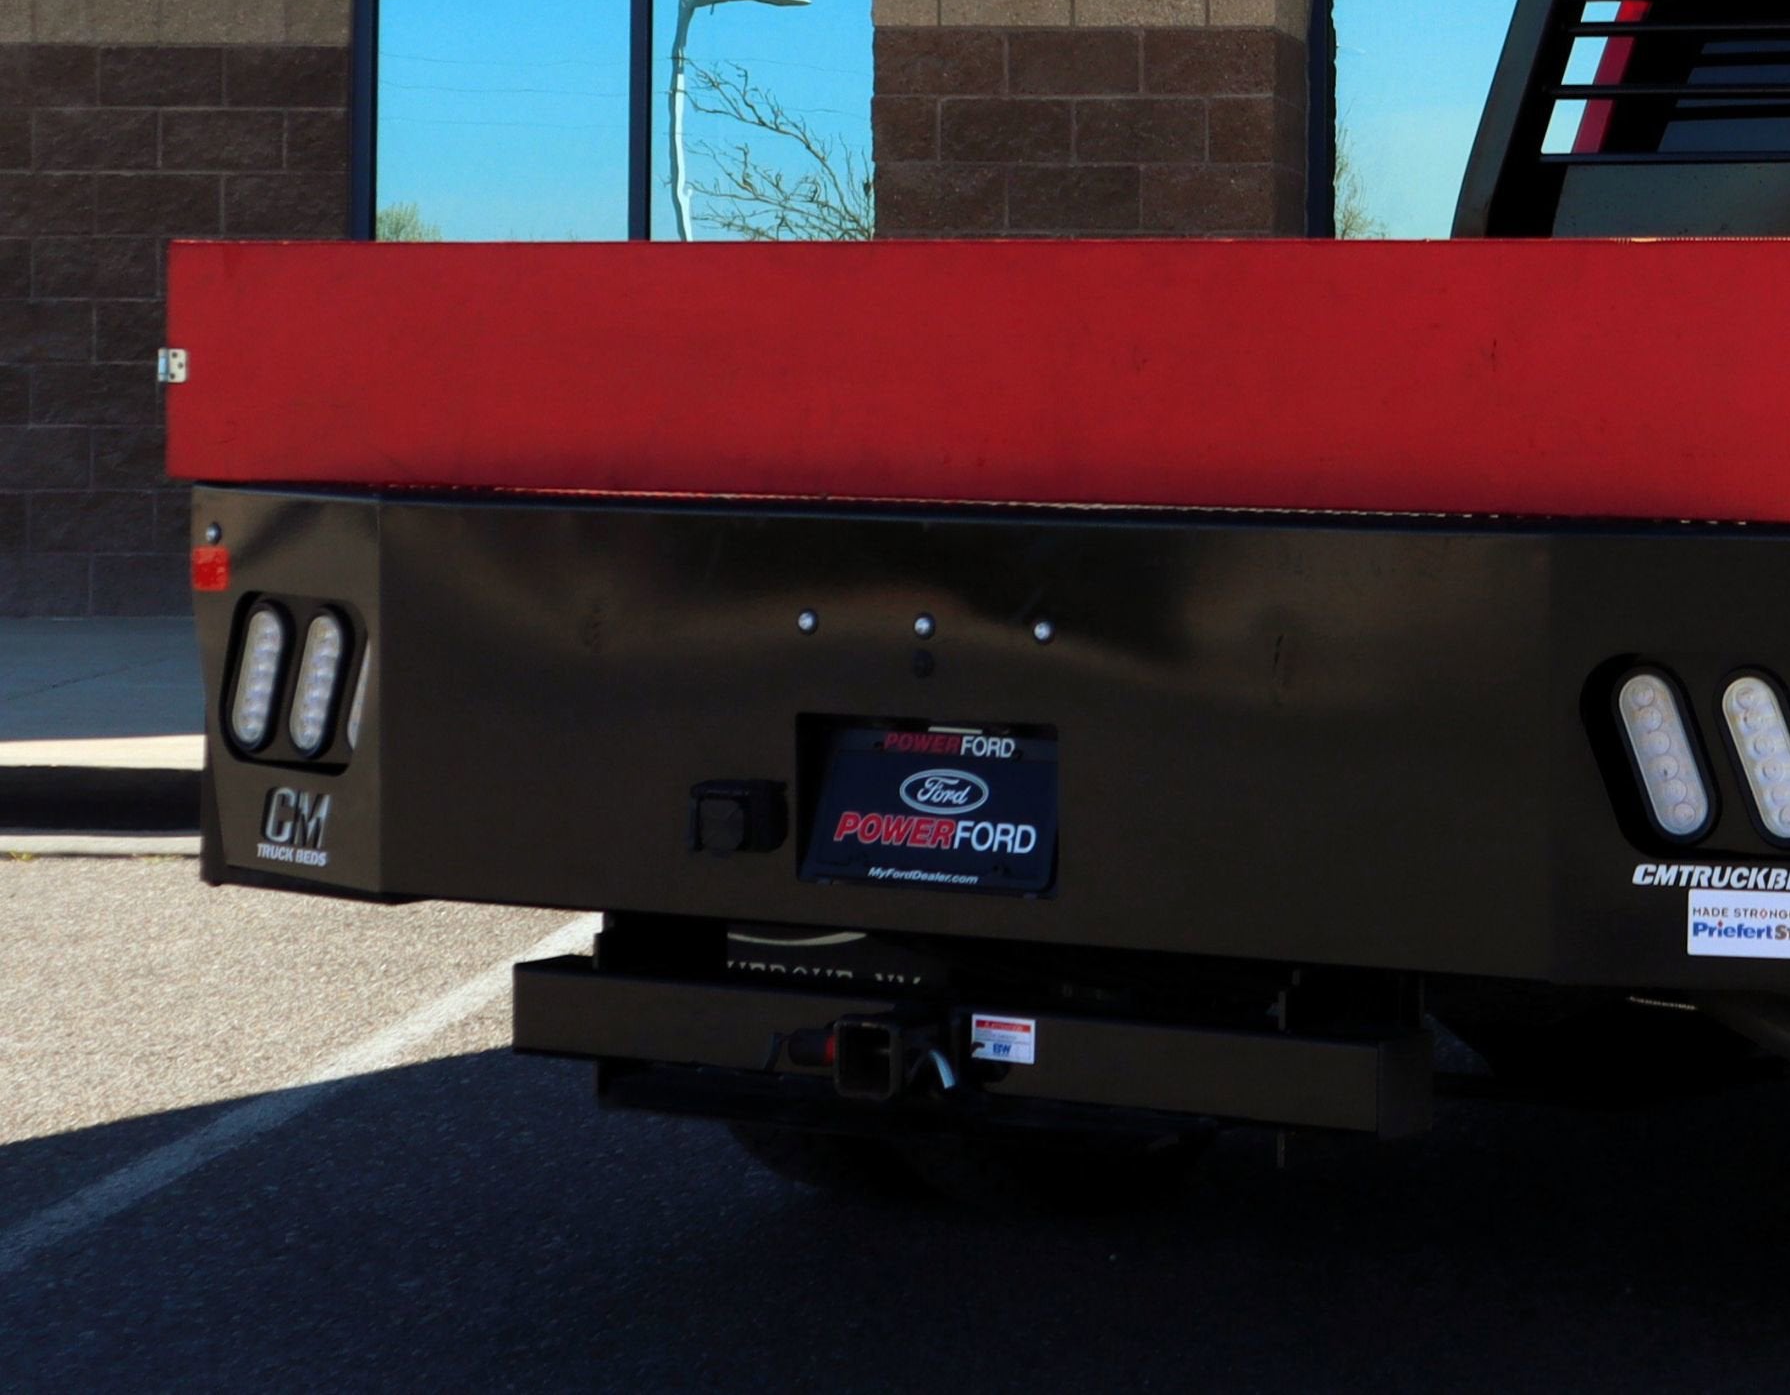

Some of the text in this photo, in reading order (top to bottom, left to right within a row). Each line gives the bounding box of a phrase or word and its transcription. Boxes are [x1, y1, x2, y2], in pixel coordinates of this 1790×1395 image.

[916, 776, 971, 805] Ford
[263, 787, 330, 848] CM
[256, 843, 327, 867] TRUCK BEDS
[868, 866, 978, 885] MyFordDealer.com
[1692, 907, 1729, 918] MADE
